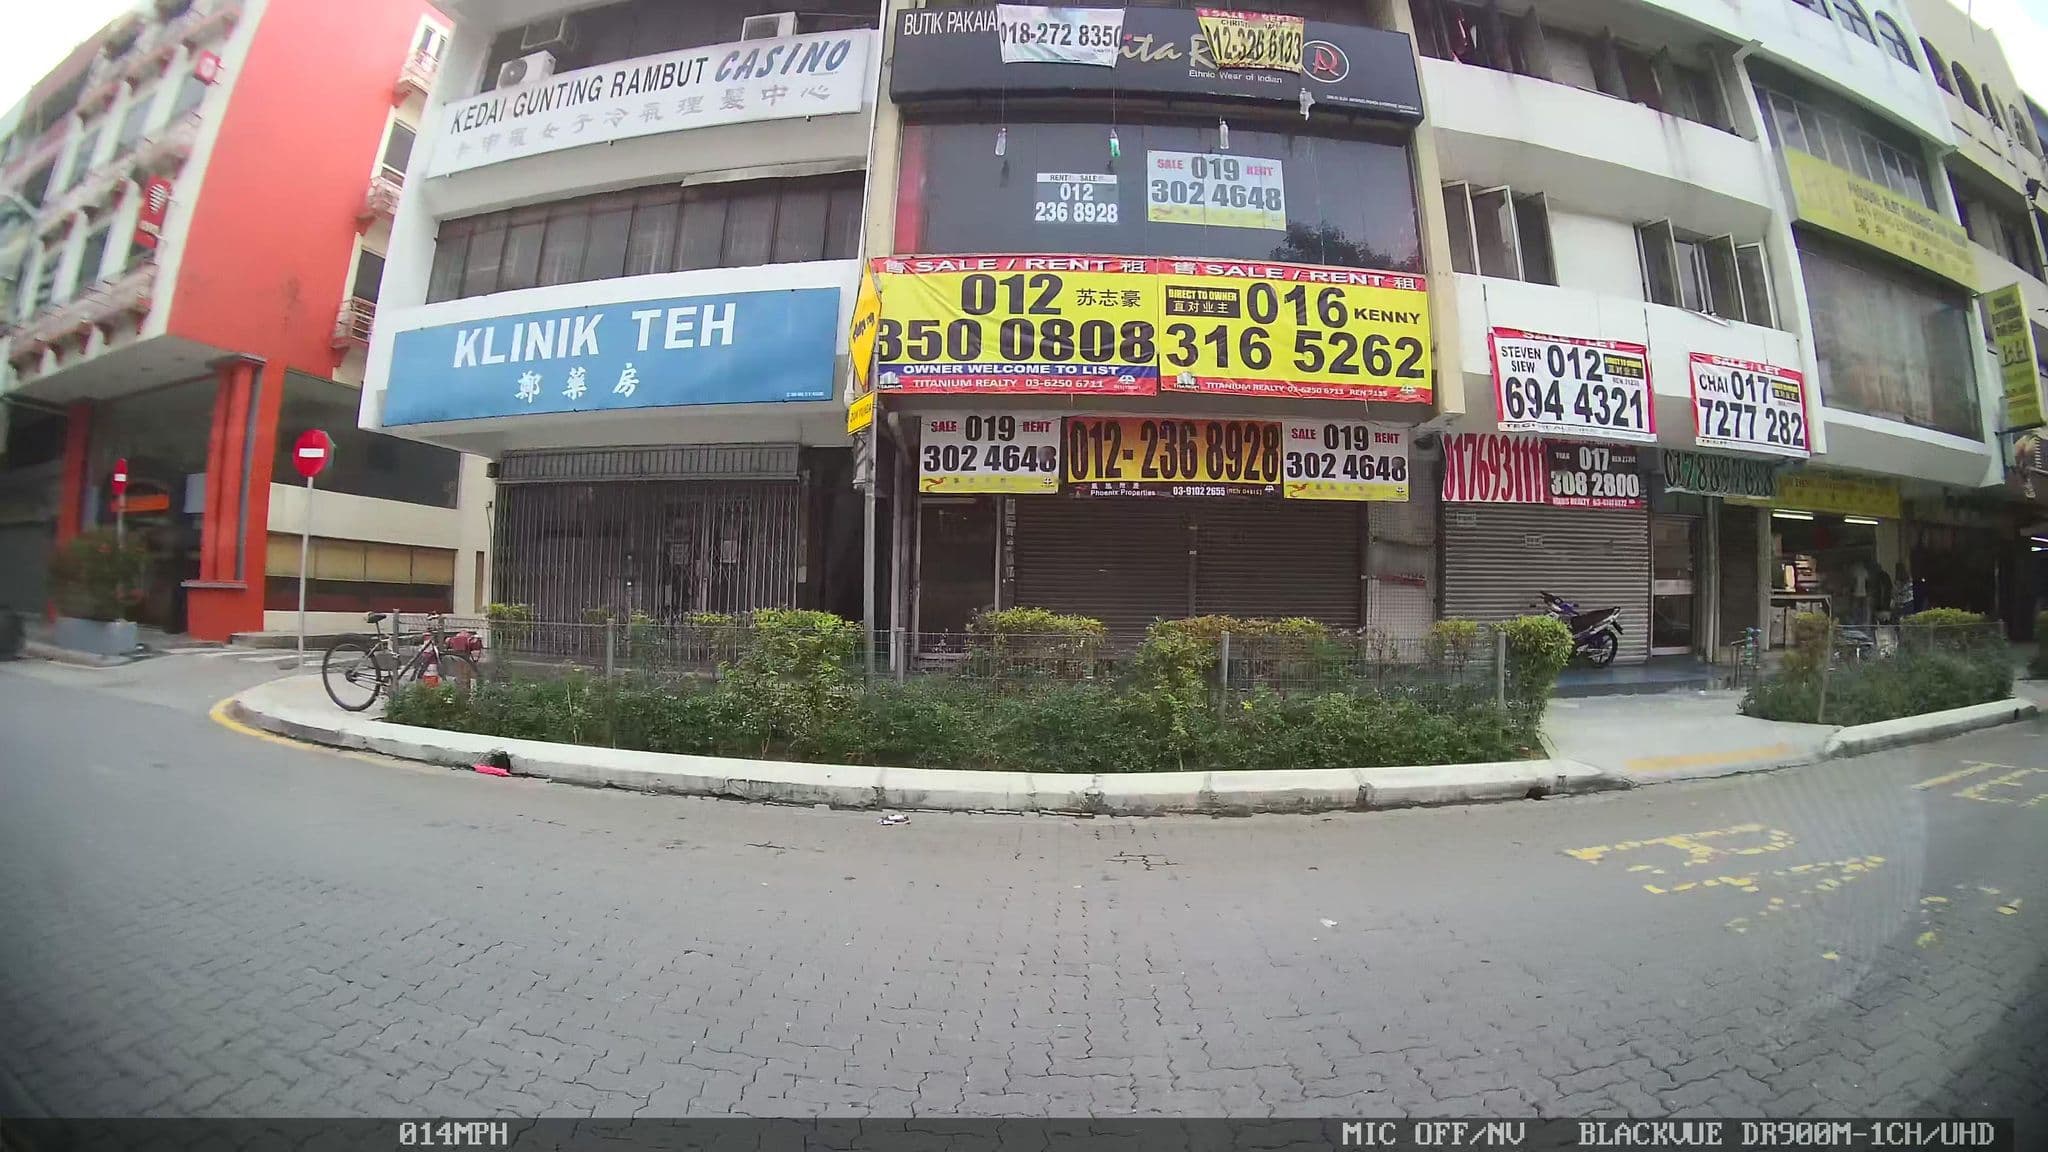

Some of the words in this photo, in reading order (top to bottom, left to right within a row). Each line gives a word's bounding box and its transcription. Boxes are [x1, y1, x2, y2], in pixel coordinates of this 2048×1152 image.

[904, 12, 943, 36] BUTIK
[947, 10, 999, 33] PAKAIA
[450, 97, 506, 135] KEDAI
[513, 74, 603, 119] GUNTING
[610, 56, 709, 98] RAMBUT
[714, 39, 851, 82] CASINO
[1220, 71, 1242, 80] Wear
[1157, 159, 1184, 169] SALE
[1191, 157, 1240, 182] 019
[1247, 166, 1274, 177] RENT
[1060, 183, 1094, 201] 012
[1152, 180, 1205, 205] 302
[1212, 183, 1281, 211] 4648
[1035, 201, 1068, 222] 236
[1073, 202, 1118, 223] 8928
[915, 258, 997, 272] SALE
[1025, 258, 1115, 272] RENT
[1122, 260, 1147, 273] 租
[1205, 265, 1284, 280] SALE
[1310, 270, 1390, 287] RENT
[961, 273, 1063, 315] 012
[1075, 287, 1141, 308] 苏志豪
[1168, 289, 1196, 300] DIRECT
[1197, 290, 1207, 300] TO
[1208, 290, 1237, 302] OWNER
[1173, 300, 1230, 314] 直对业主
[1247, 282, 1348, 328] 016
[1354, 307, 1421, 325] KENNY
[453, 313, 604, 368] KLINIK
[632, 302, 737, 351] TEH
[879, 318, 982, 362] 350
[1000, 318, 1155, 363] 0808
[1166, 323, 1272, 370] 316
[1293, 330, 1426, 379] 5262
[1501, 346, 1541, 360] STEVEN
[1547, 345, 1604, 382] 012
[903, 365, 964, 376] OWNER
[968, 364, 1050, 376] WELCOME
[1054, 365, 1077, 376] TO
[1082, 365, 1120, 376] LIST
[1511, 361, 1535, 374] SIEW
[913, 378, 972, 388] TITANIUM
[976, 378, 1018, 387] REALTY
[1025, 378, 1073, 388] 03-6250
[1075, 379, 1104, 388] 6711
[1206, 381, 1251, 391] TITANIUM
[1253, 383, 1285, 392] REALTY
[1699, 374, 1728, 393] CHAI
[1731, 371, 1769, 404] 017
[1505, 376, 1565, 421] 694
[1574, 383, 1643, 429] 4321
[930, 421, 957, 432] SALE
[965, 415, 1015, 441] 019
[1023, 421, 1051, 433] RENT
[1699, 398, 1757, 440] 7277
[1765, 408, 1804, 446] 282
[1291, 428, 1317, 440] SALE
[1324, 424, 1369, 451] 019
[1374, 432, 1400, 444] RENT
[924, 445, 977, 472] 302
[984, 445, 1056, 472] 4648
[1141, 420, 1198, 480] 236
[1206, 421, 1279, 482] 8928
[1579, 447, 1609, 471] 017
[1287, 452, 1336, 479] 302
[1343, 454, 1406, 481] 4648
[1091, 489, 1118, 497] Phoenix
[1121, 488, 1156, 497] Properties
[1173, 486, 1204, 496] 03-9102
[1206, 487, 1225, 496] 2655
[1551, 470, 1587, 496] 308
[1592, 472, 1639, 498] 2800
